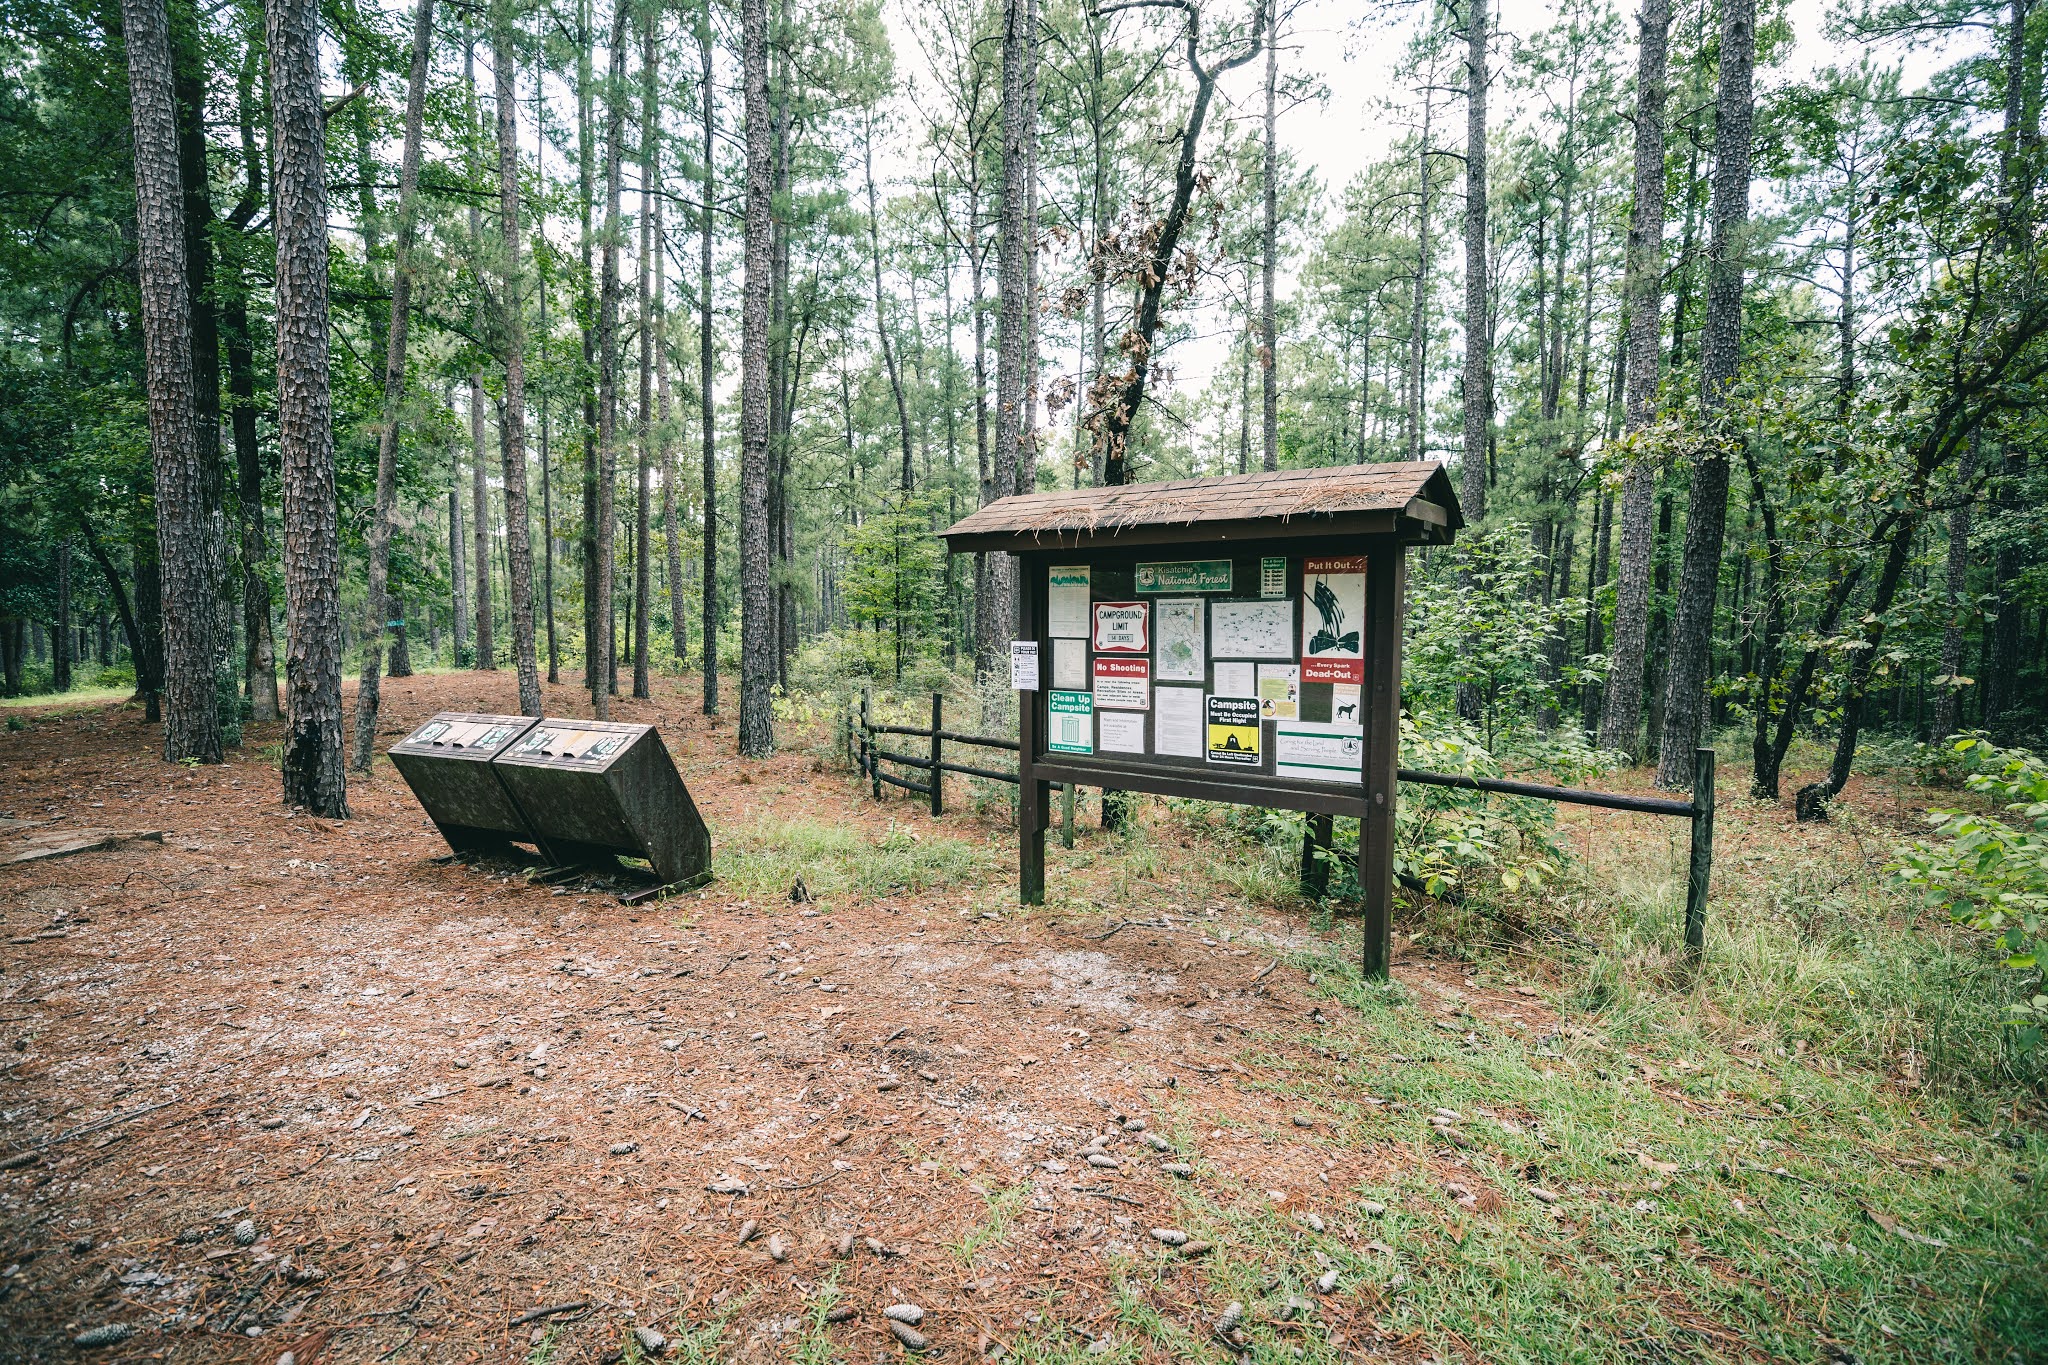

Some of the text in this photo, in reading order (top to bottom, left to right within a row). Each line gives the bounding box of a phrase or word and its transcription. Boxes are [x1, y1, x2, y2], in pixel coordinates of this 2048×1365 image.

[1334, 561, 1362, 569] Out...
[1158, 572, 1228, 585] National Forest
[1100, 611, 1142, 619] CAMPGROUND
[1110, 664, 1146, 673] Shooting
[1306, 670, 1351, 678] Dead-Out
[1052, 693, 1090, 704] Clean Up
[1052, 702, 1090, 712] Campsite
[1210, 700, 1256, 710] Campsite
